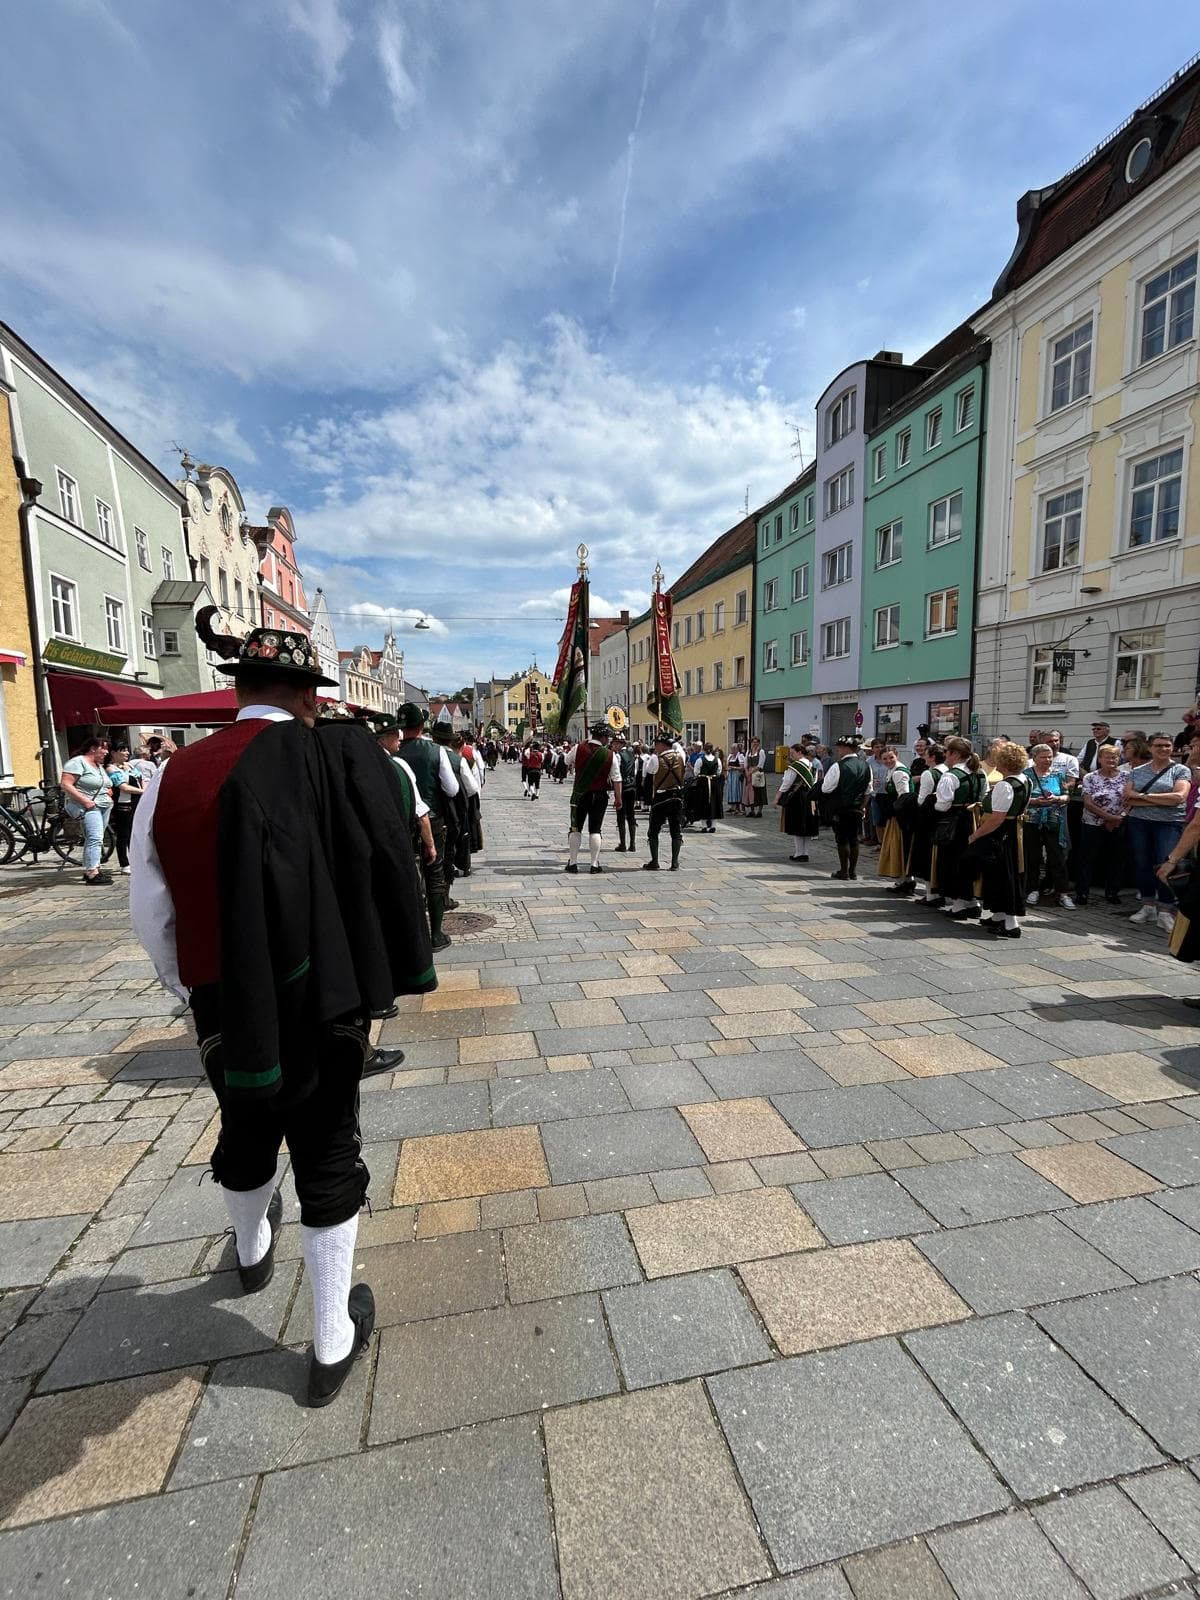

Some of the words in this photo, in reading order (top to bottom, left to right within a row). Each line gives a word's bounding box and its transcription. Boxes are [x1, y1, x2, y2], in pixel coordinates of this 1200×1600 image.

[45, 643, 59, 657] Eis
[60, 647, 96, 665] Gelateria
[1056, 655, 1073, 667] vhs
